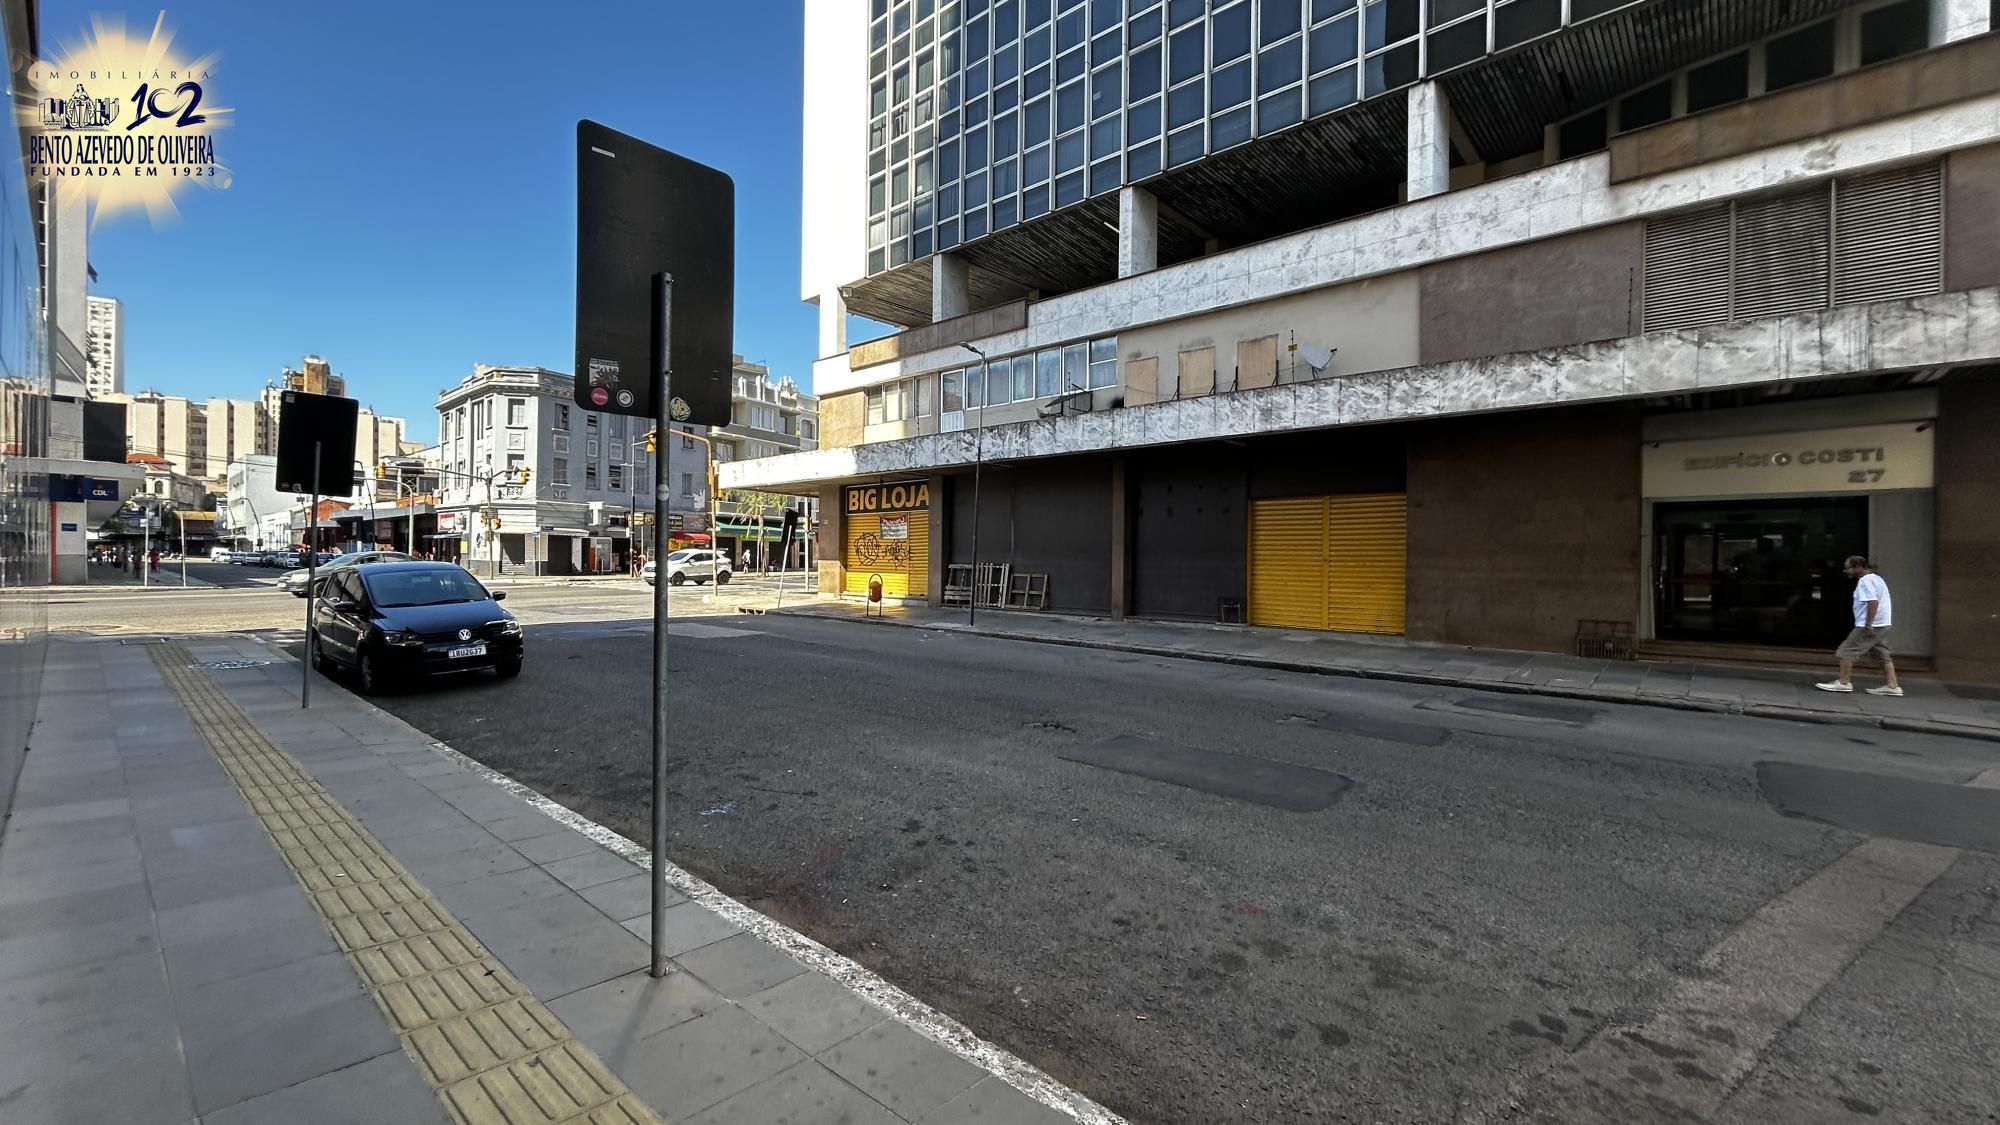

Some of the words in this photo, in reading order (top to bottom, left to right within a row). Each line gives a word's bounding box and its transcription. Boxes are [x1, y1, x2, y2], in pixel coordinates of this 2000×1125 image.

[1797, 447, 1885, 466] COSTI
[1847, 468, 1886, 483] 27
[848, 489, 877, 510] BIG
[881, 485, 929, 508] LOJA
